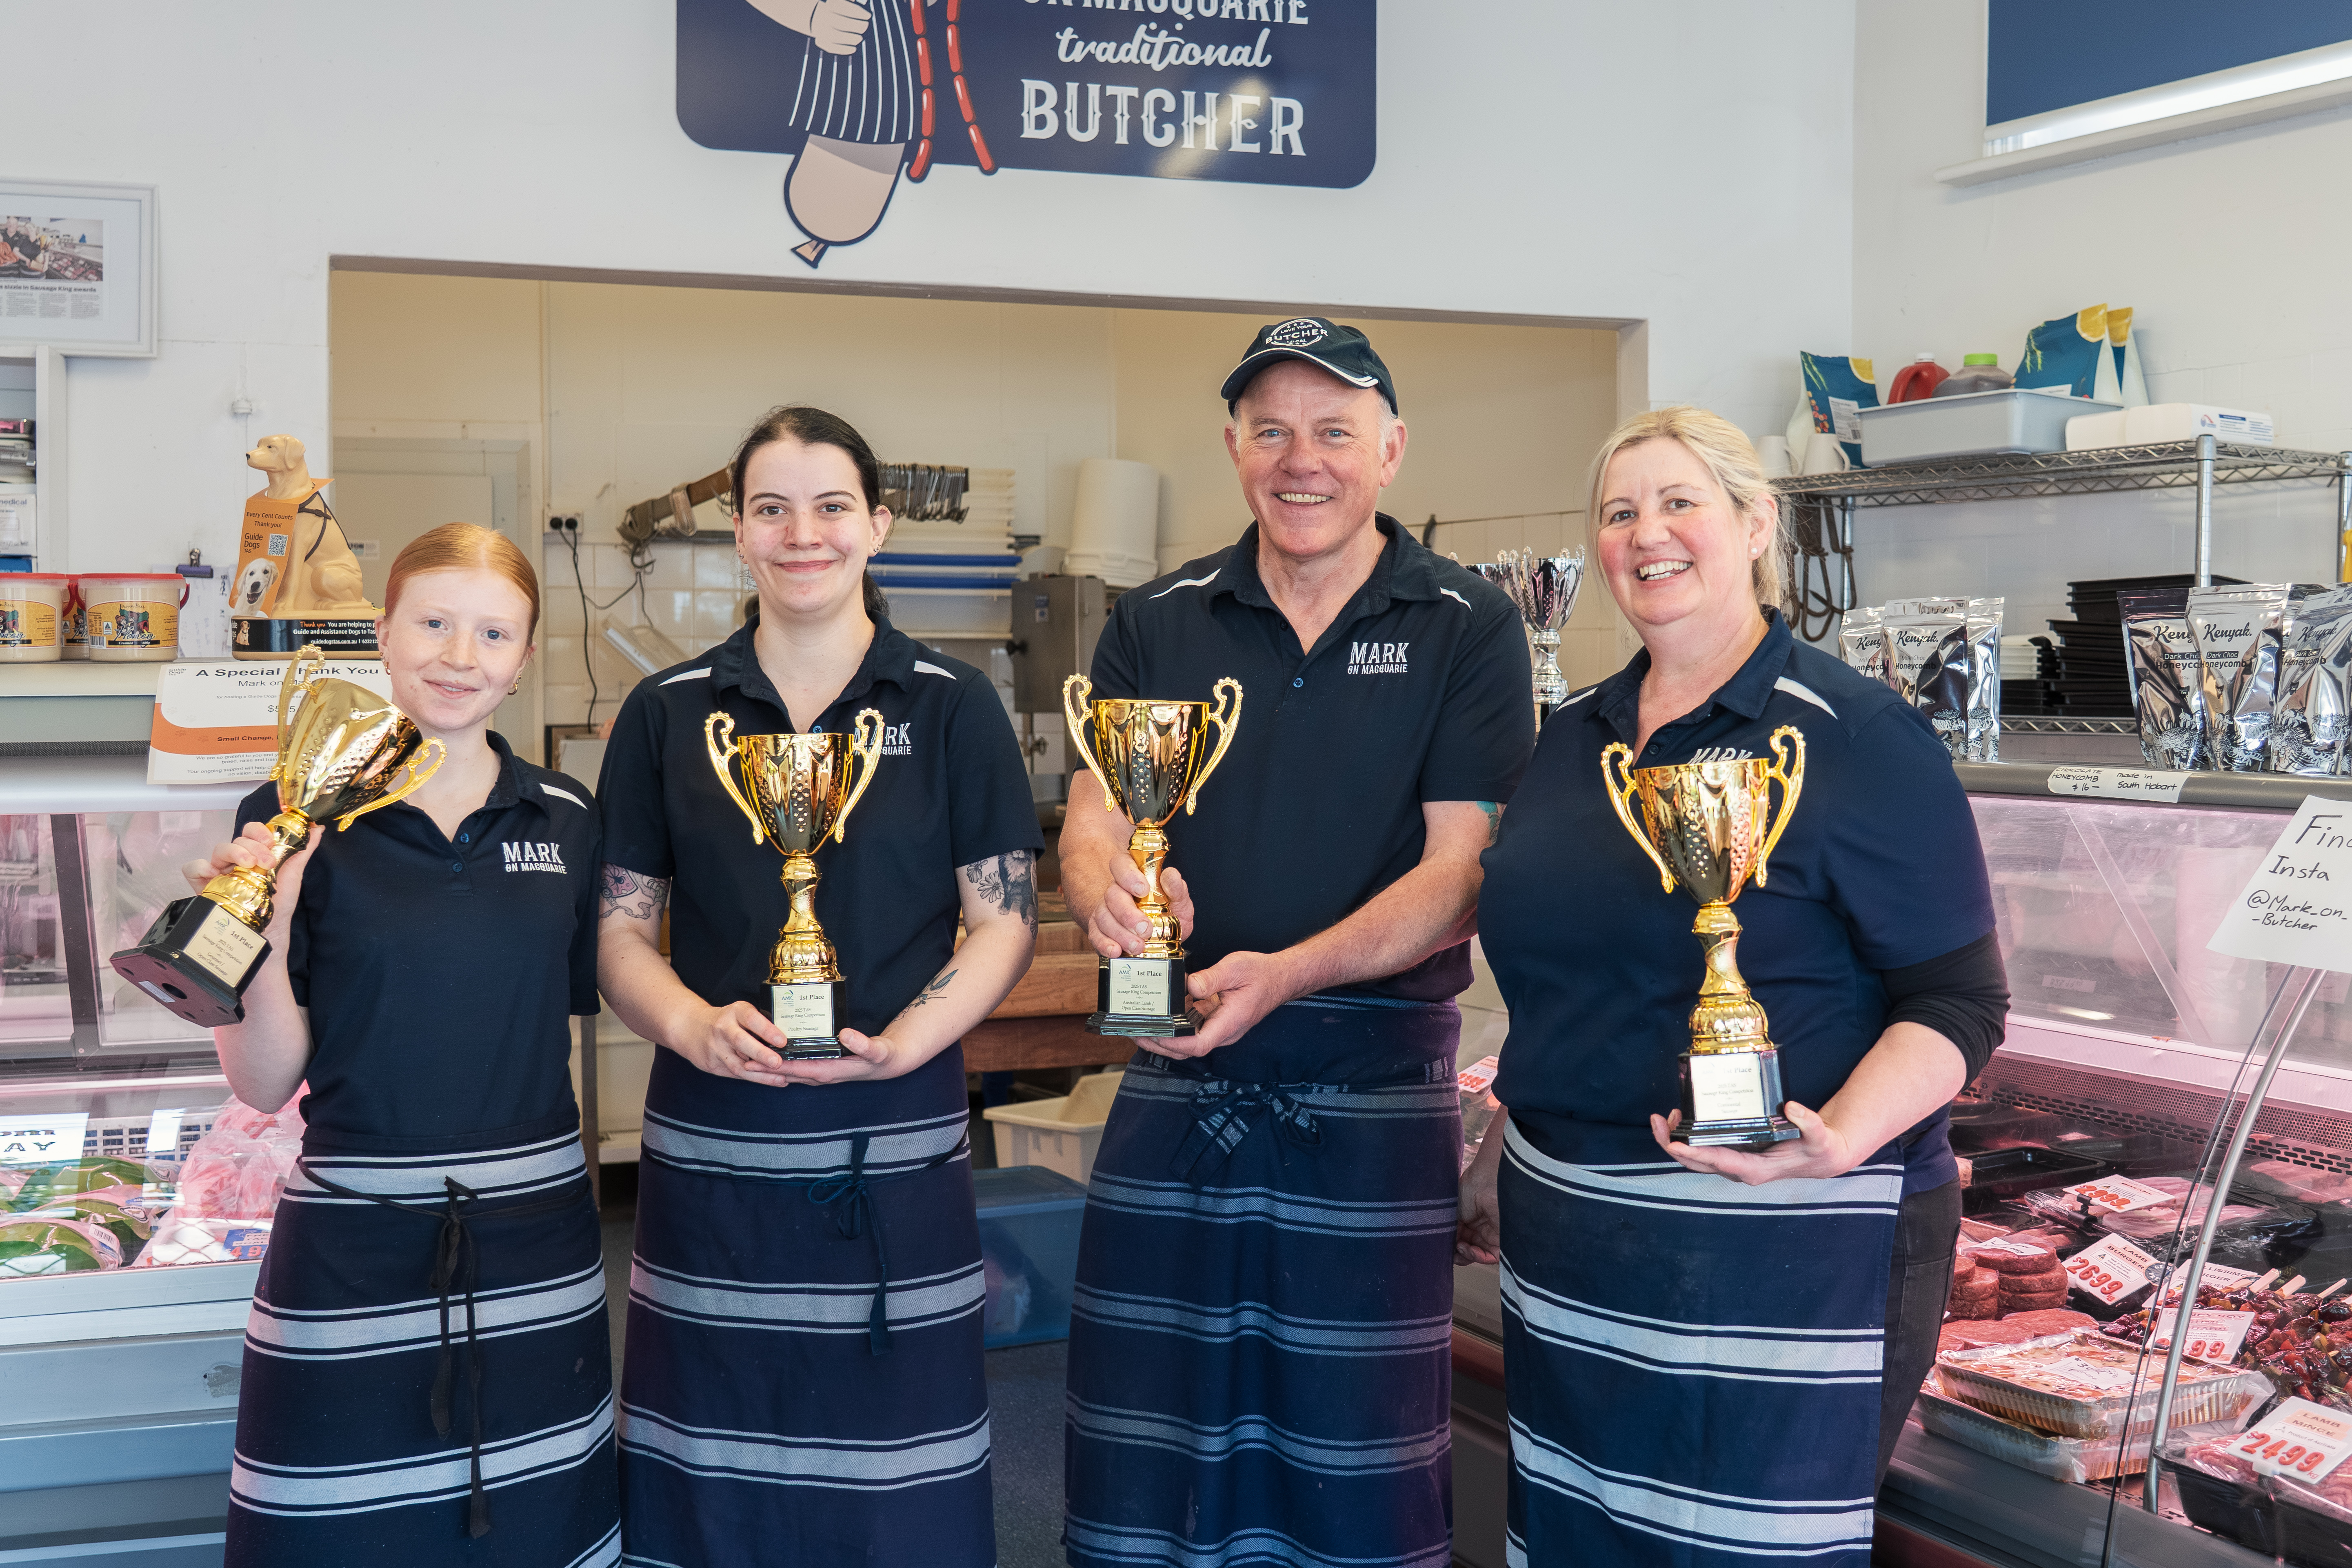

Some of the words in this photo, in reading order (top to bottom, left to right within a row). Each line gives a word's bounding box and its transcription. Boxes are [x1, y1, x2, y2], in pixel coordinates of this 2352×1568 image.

[1056, 22, 1272, 71] traditional
[1020, 79, 1306, 156] BUTCHER
[1266, 329, 1328, 344] BUTCHER
[244, 540, 260, 549] Dogs
[113, 625, 155, 648] Honey
[2203, 622, 2252, 642] Kenyak.
[1348, 642, 1409, 664] MARK
[1348, 665, 1359, 674] ON
[1361, 664, 1408, 674] MACQUARIE
[1896, 662, 1937, 671] Honeycomb
[2201, 660, 2247, 669] Honeycomb
[2283, 656, 2326, 667] Honeycomb
[215, 668, 280, 677] Special
[2052, 773, 2099, 782] HONEYCOMB
[2117, 781, 2139, 789] South
[2145, 782, 2177, 791] Hobart
[502, 842, 564, 864] MARK
[506, 863, 518, 872] ON
[521, 862, 567, 874] MACQUARIE
[2268, 855, 2330, 881] Insta
[231, 931, 240, 939] 1st
[239, 937, 254, 950] Place
[202, 934, 215, 946] Sausage
[223, 949, 242, 965] Competition
[208, 952, 222, 964] Gourmet
[207, 959, 215, 967] Class
[214, 965, 228, 976] Sausage
[2108, 1246, 2145, 1270] BURGER
[2123, 1247, 2148, 1262] LAMB
[2202, 1273, 2231, 1282] RGER
[2292, 1420, 2335, 1436] MINCE
[2303, 1413, 2341, 1428] LAMB
[2288, 1431, 2307, 1440] Product
[2314, 1440, 2336, 1450] Australia
[2307, 1471, 2319, 1479] kg
